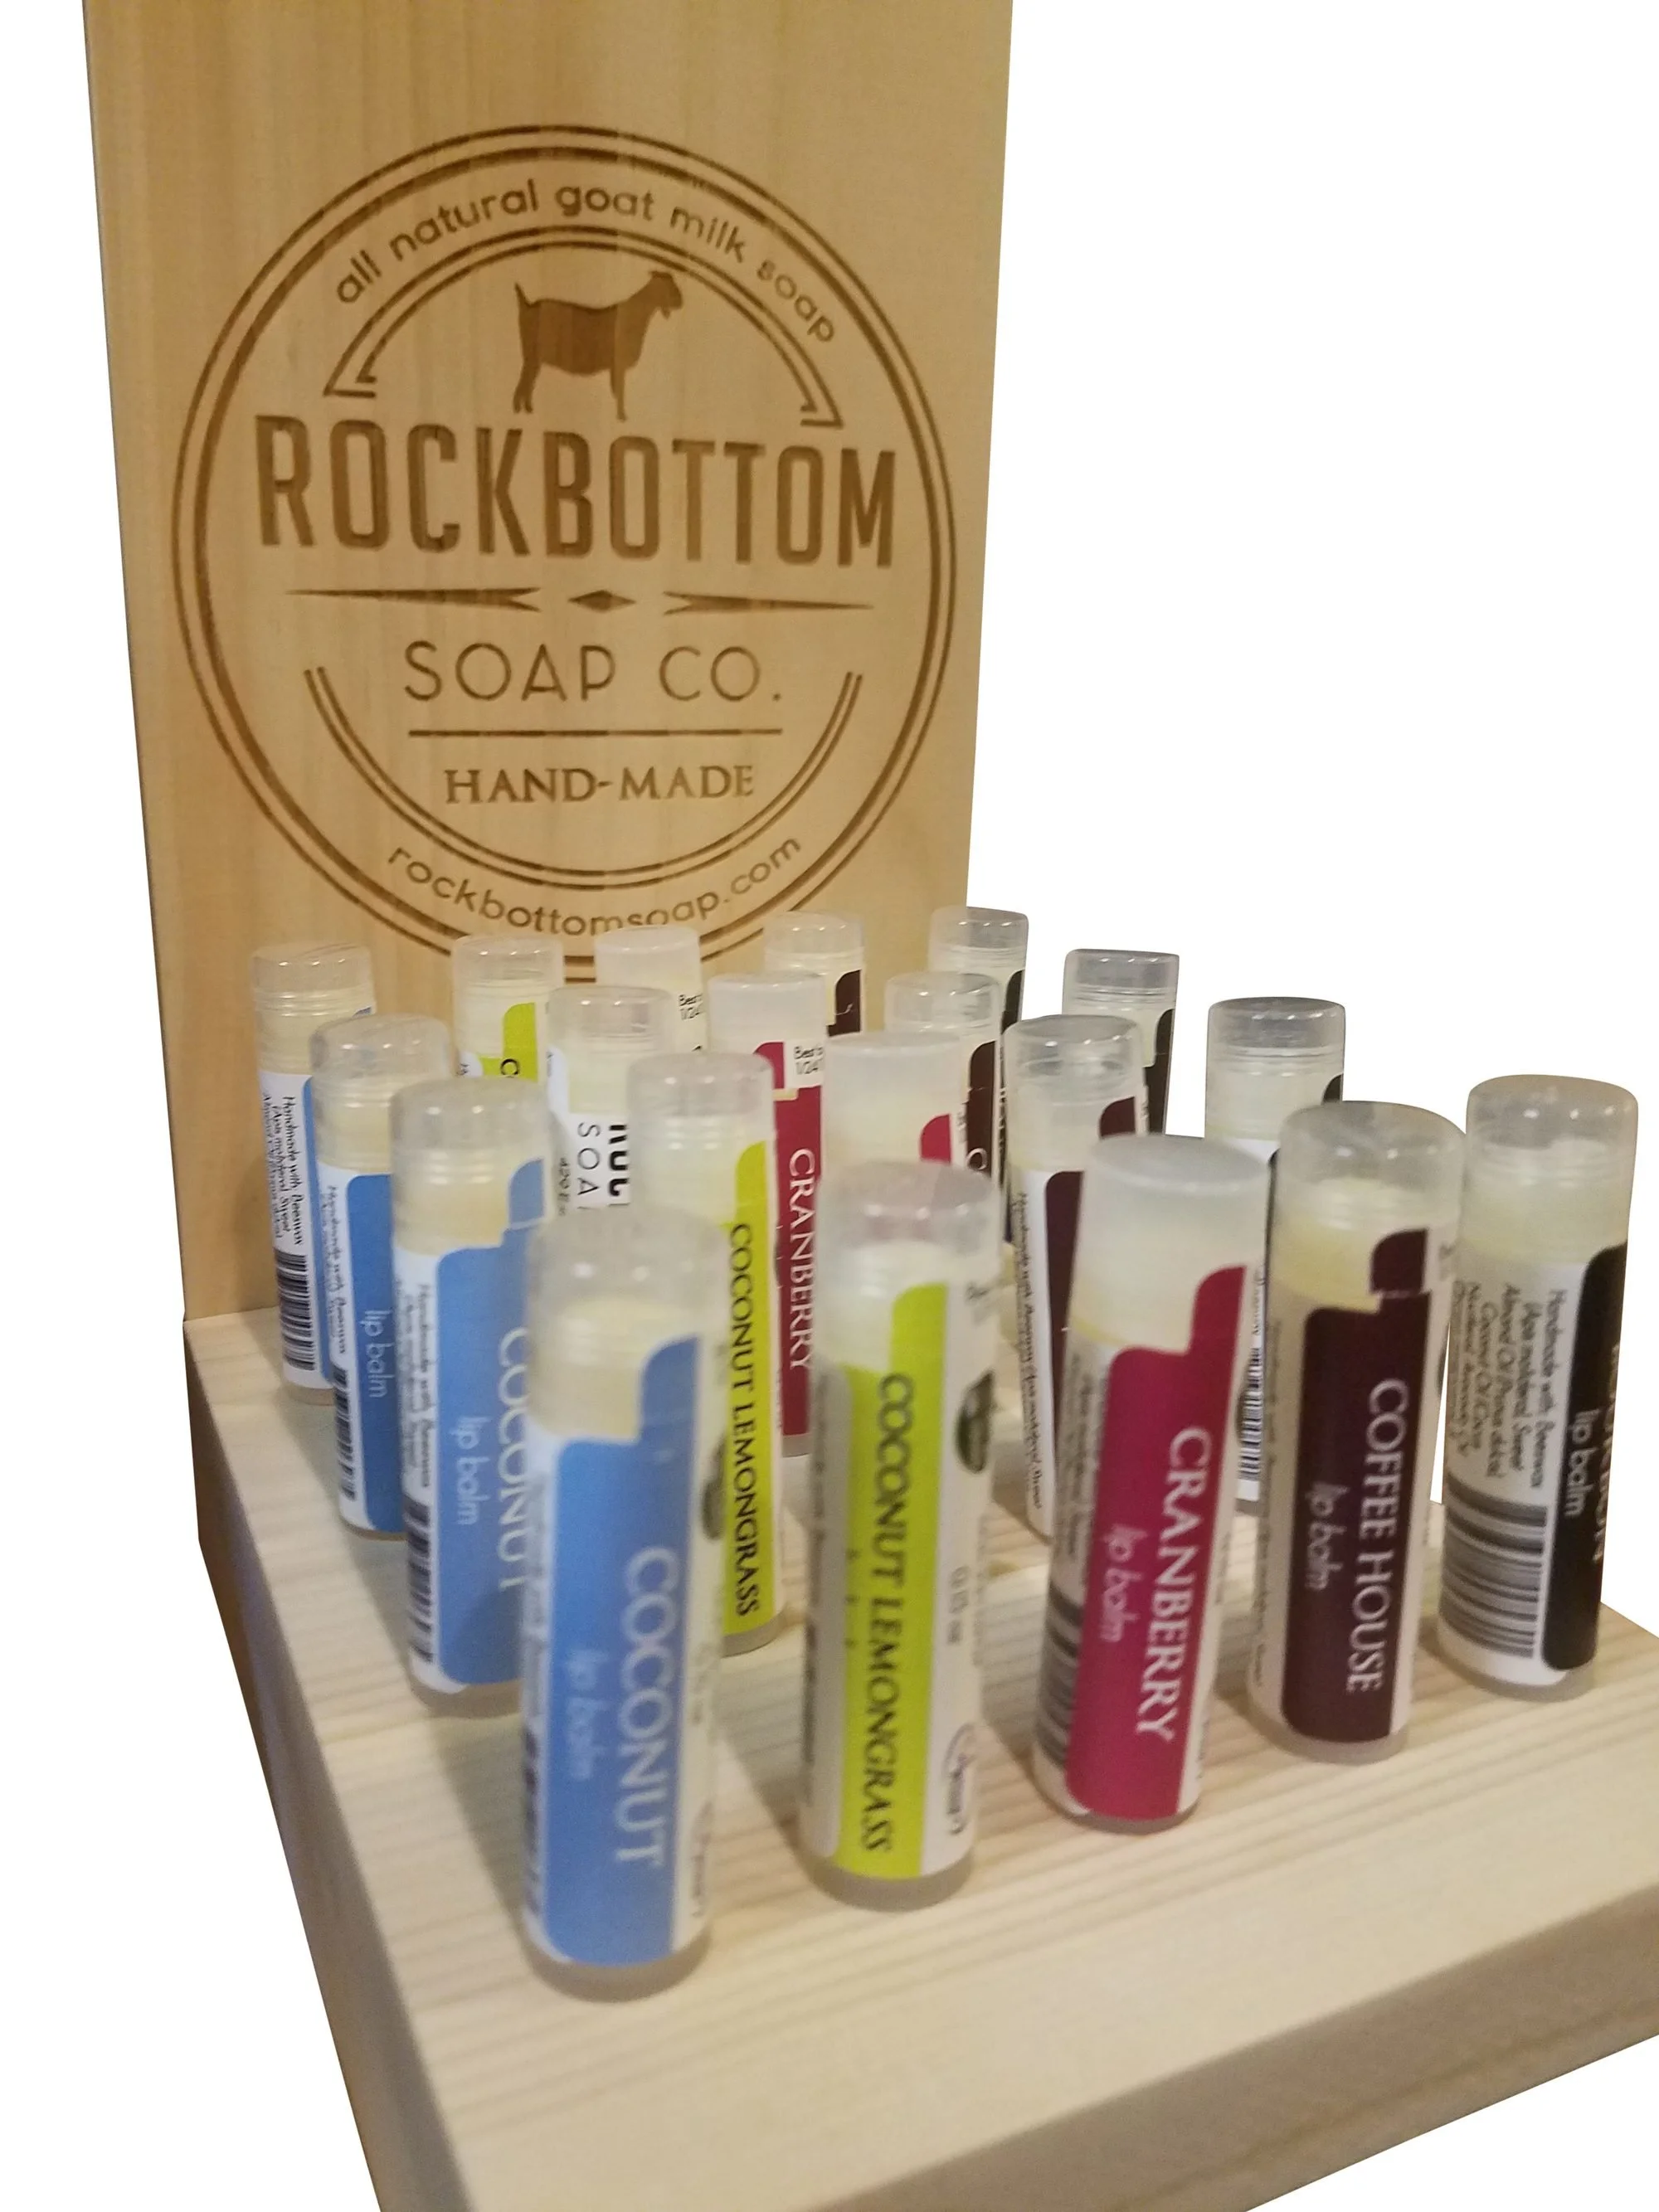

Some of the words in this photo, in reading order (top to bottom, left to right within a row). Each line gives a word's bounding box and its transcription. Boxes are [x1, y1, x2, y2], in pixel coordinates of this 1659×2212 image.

[336, 247, 382, 307] all
[388, 177, 541, 266] natural
[553, 181, 656, 222] goat
[669, 204, 747, 265] milk
[756, 255, 836, 345] soap
[254, 413, 897, 570] ROCKBOTTOM
[403, 639, 616, 703] SOAP
[659, 644, 784, 703] CO.
[444, 764, 756, 806] HAND-MADE
[387, 834, 802, 938] rockbottomsoap.com
[577, 1121, 601, 1209] SOA
[359, 1309, 393, 1337] lip
[729, 1222, 756, 1392] COCONUT
[789, 1148, 816, 1370] CRANBERRY
[367, 1342, 396, 1398] balm
[456, 1456, 491, 1526] balm
[731, 1403, 761, 1616] LEMONGRASS
[871, 1372, 914, 1587] COCONUT
[1359, 1376, 1411, 1541] COFFEE
[1564, 1446, 1601, 1519] balm
[1134, 1426, 1214, 1743] CRANBERRY
[1345, 1547, 1395, 1694] HOUSE
[615, 1545, 680, 1868] COCONUT
[860, 1592, 906, 1854] LEMONGRASS
